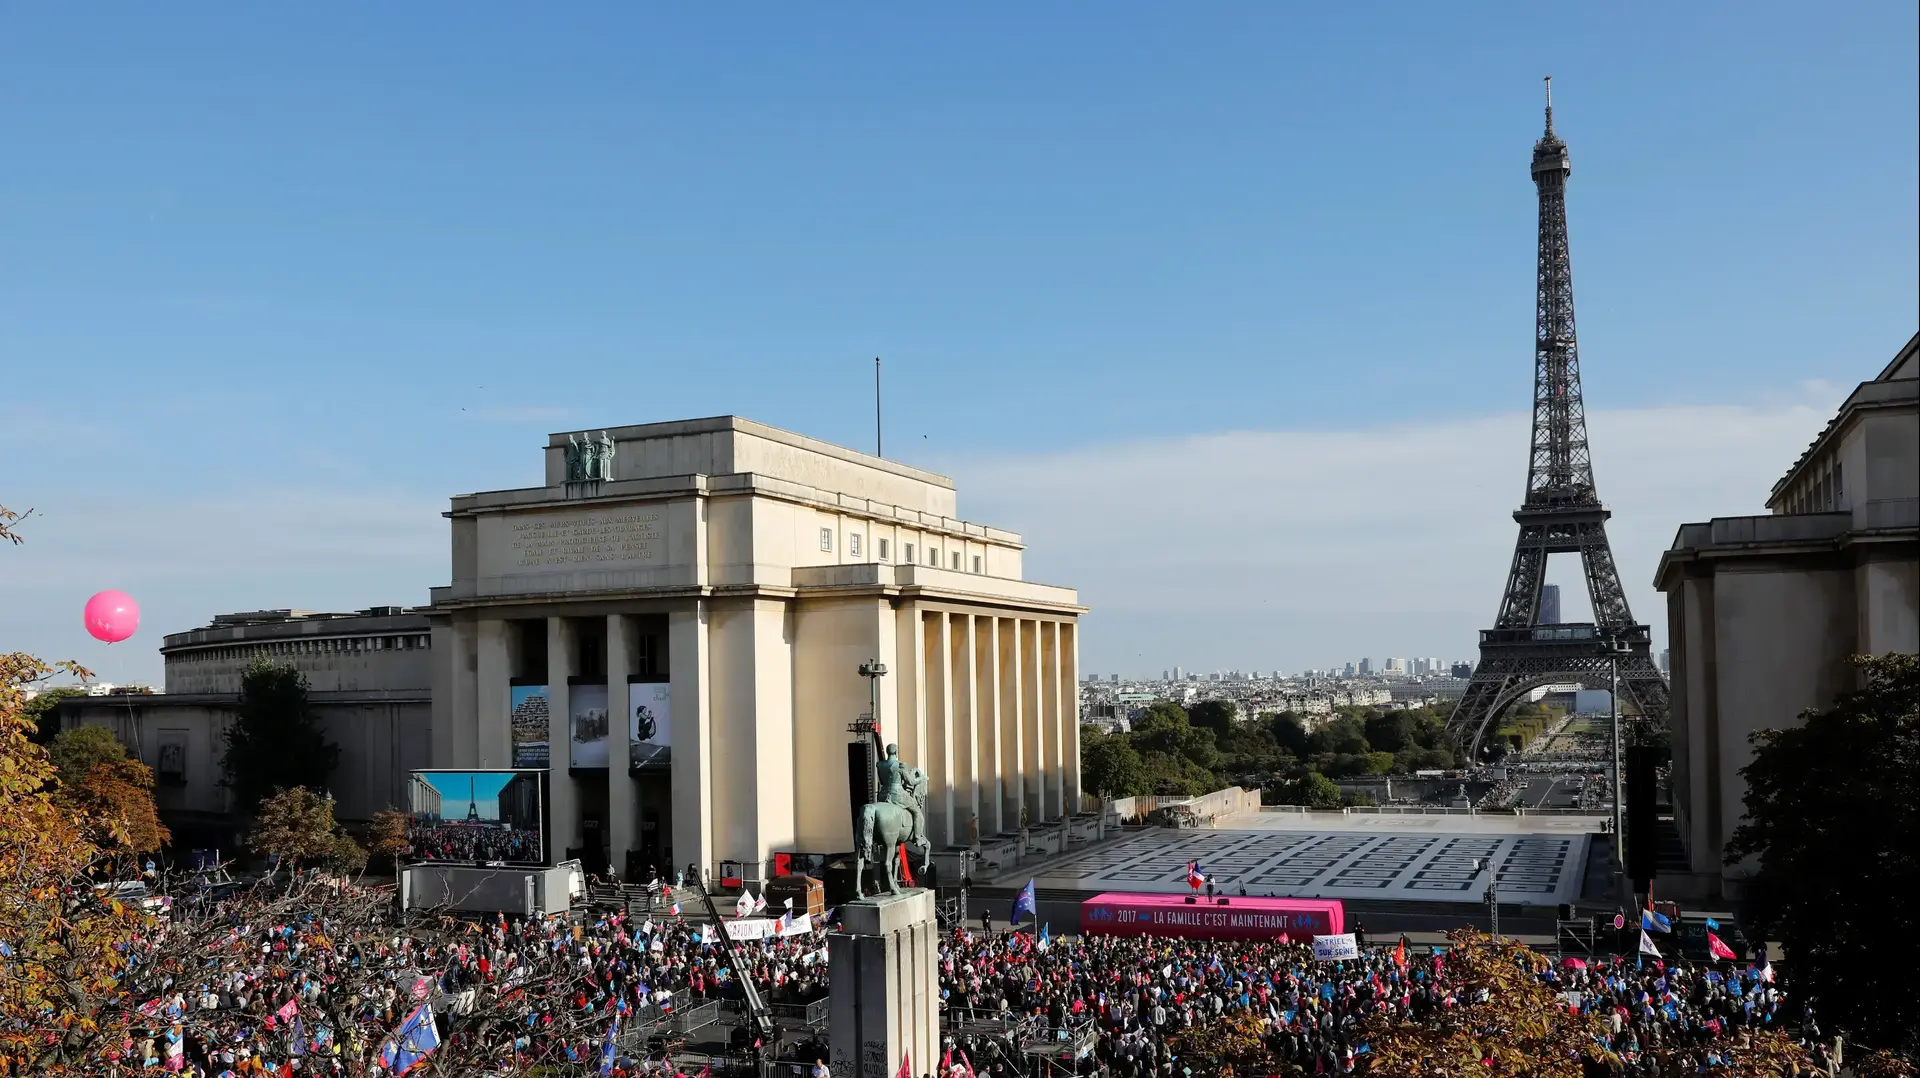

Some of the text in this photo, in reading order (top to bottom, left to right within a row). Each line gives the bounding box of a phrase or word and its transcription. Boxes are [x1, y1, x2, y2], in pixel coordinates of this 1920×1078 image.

[1117, 909, 1289, 928] 2017 LA FAMILLE C'EST MAINTENANT
